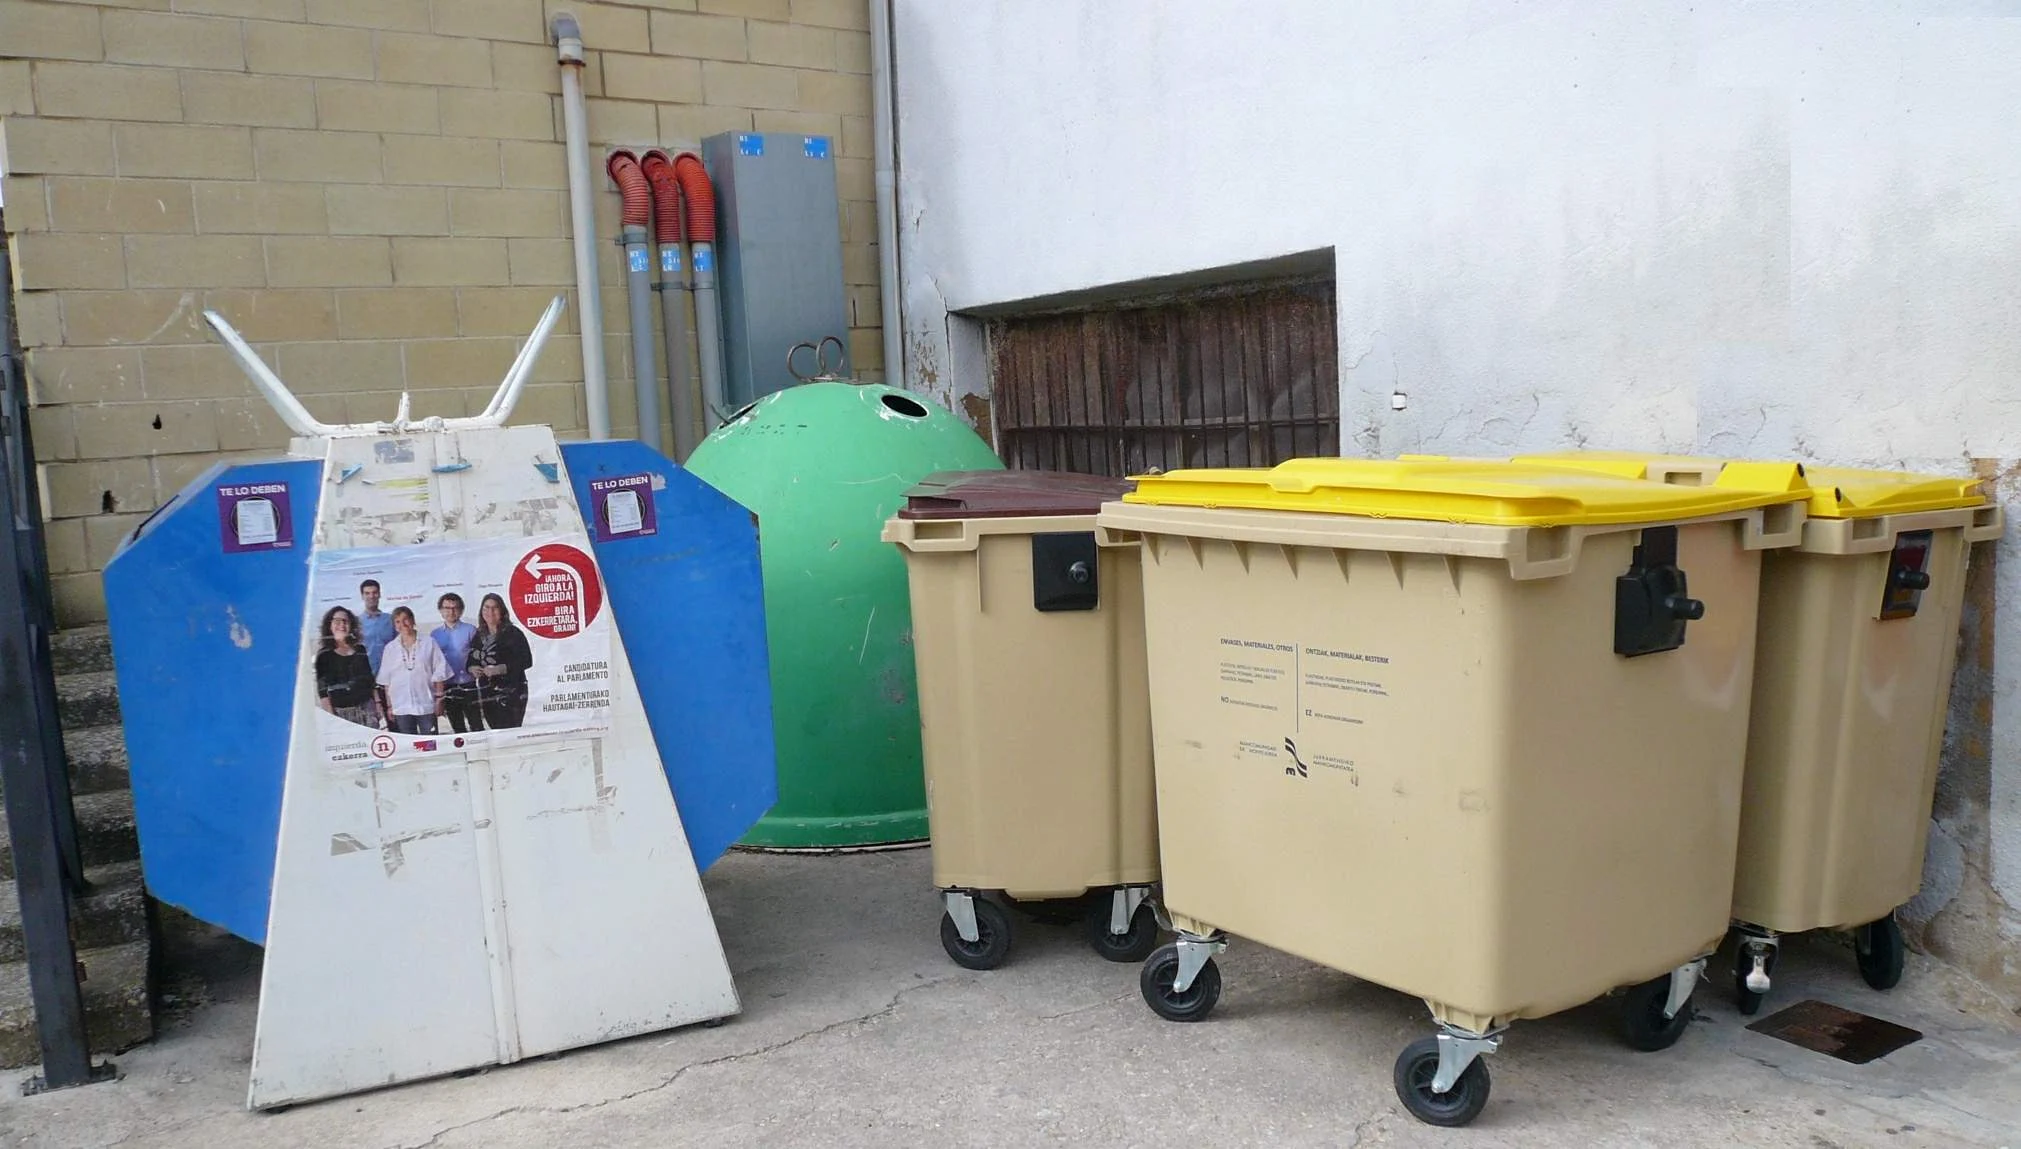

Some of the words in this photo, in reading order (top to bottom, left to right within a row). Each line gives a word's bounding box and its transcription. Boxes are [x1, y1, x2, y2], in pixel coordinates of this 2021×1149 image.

[591, 482, 604, 490] TE
[605, 480, 617, 489] LO
[619, 476, 648, 486] DEBEN
[219, 488, 234, 496] TE
[235, 487, 249, 496] LO
[251, 484, 286, 494] DEBEN
[535, 583, 555, 593] GIRO
[556, 583, 563, 591] A
[563, 582, 574, 591] LA
[524, 591, 575, 605] IZQUIERDA!
[554, 605, 575, 615] BIRA
[564, 661, 608, 673] CANDIDATURA
[557, 675, 566, 683] AL
[567, 670, 609, 682] PARLAMENTO
[550, 689, 610, 702] PARLAMENTURAKO
[1220, 695, 1229, 704] NO
[542, 699, 610, 712] HAUTAGAI-ZERRENDA
[1305, 709, 1312, 717] EZ
